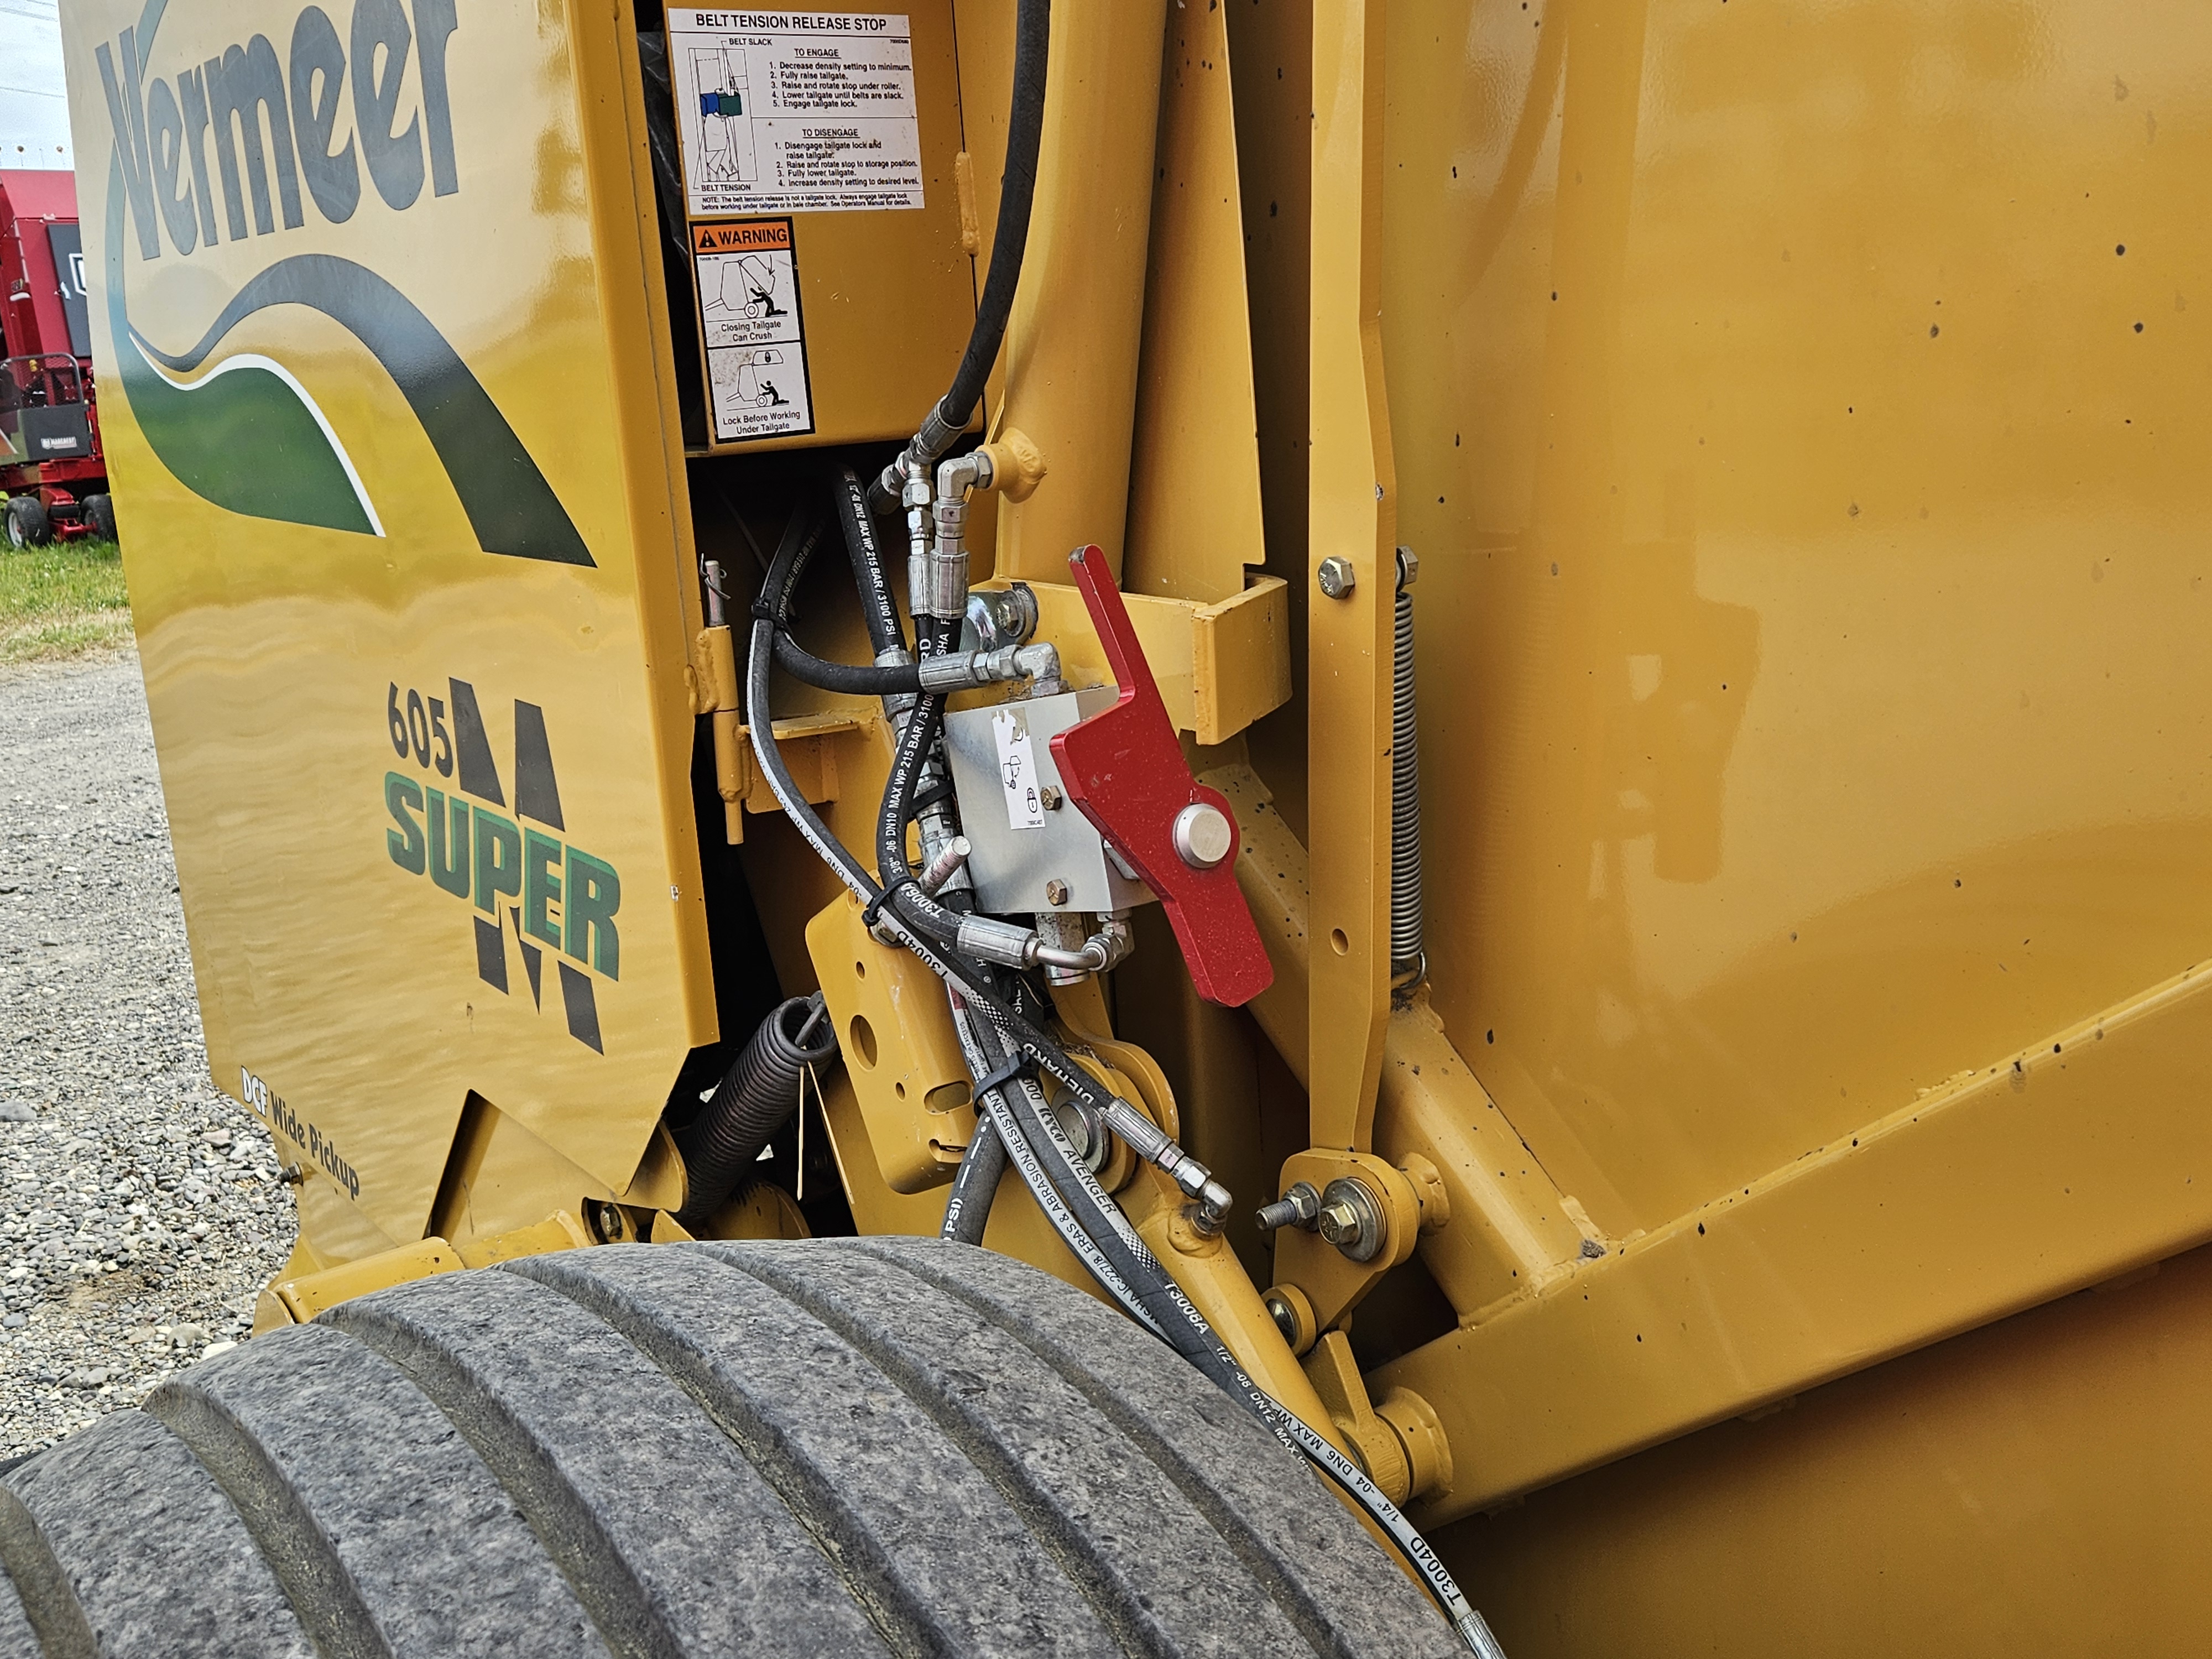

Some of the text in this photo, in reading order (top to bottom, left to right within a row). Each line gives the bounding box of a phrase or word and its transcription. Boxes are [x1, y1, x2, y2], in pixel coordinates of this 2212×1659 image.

[696, 13, 886, 30] BELT TENSION RELEASE STOP
[781, 71, 798, 81] Fully
[820, 72, 848, 81] tailgate.
[816, 62, 841, 71] density
[843, 63, 867, 72] setting
[806, 91, 832, 100] tailgate
[842, 82, 857, 91] stop
[784, 100, 811, 109] Engage
[813, 100, 838, 108] tailgate
[95, 0, 458, 260] Vermeer
[785, 142, 823, 151] Disengage
[788, 169, 805, 178] Fully
[829, 169, 857, 178] tailgate.
[891, 160, 917, 169] position.
[819, 179, 843, 188] density
[845, 179, 867, 187] setting
[718, 228, 787, 246] WARNING
[721, 321, 781, 332] Closing Tailgate
[733, 332, 772, 342] Can Crush
[723, 411, 801, 426] Lock Before Working
[737, 422, 790, 434] Under Tailgate
[863, 537, 873, 551] WP
[866, 551, 878, 567] 215
[870, 567, 883, 588] BAR
[878, 593, 891, 616] 3100
[884, 617, 896, 635] PSI
[919, 693, 935, 719] 3100
[388, 681, 453, 778] 605
[907, 725, 924, 750] BAR
[901, 749, 914, 768] 215
[894, 769, 907, 786] WP
[889, 785, 902, 809] MAX
[885, 812, 897, 836] DN10
[385, 771, 620, 982] SUPER
[1023, 1043, 1095, 1104] DIEHARD
[987, 1089, 1027, 1154] RESISTANT
[241, 1065, 360, 1202] DCF Wide Pickup
[1020, 1151, 1063, 1217] ABRASION
[945, 1197, 964, 1233] PSI)
[1060, 1213, 1069, 1222] &
[1063, 1150, 1117, 1214] AVENGER
[1164, 1281, 1210, 1334] T3008A
[1235, 1371, 1252, 1389] -08
[1250, 1392, 1276, 1423] DN12
[1274, 1427, 1298, 1455] MAX
[1293, 1422, 1324, 1451] MAX
[1326, 1450, 1354, 1477] DN6
[1355, 1476, 1375, 1494] -04
[1376, 1502, 1399, 1524] 1/4"
[1410, 1536, 1462, 1606] T3004D
